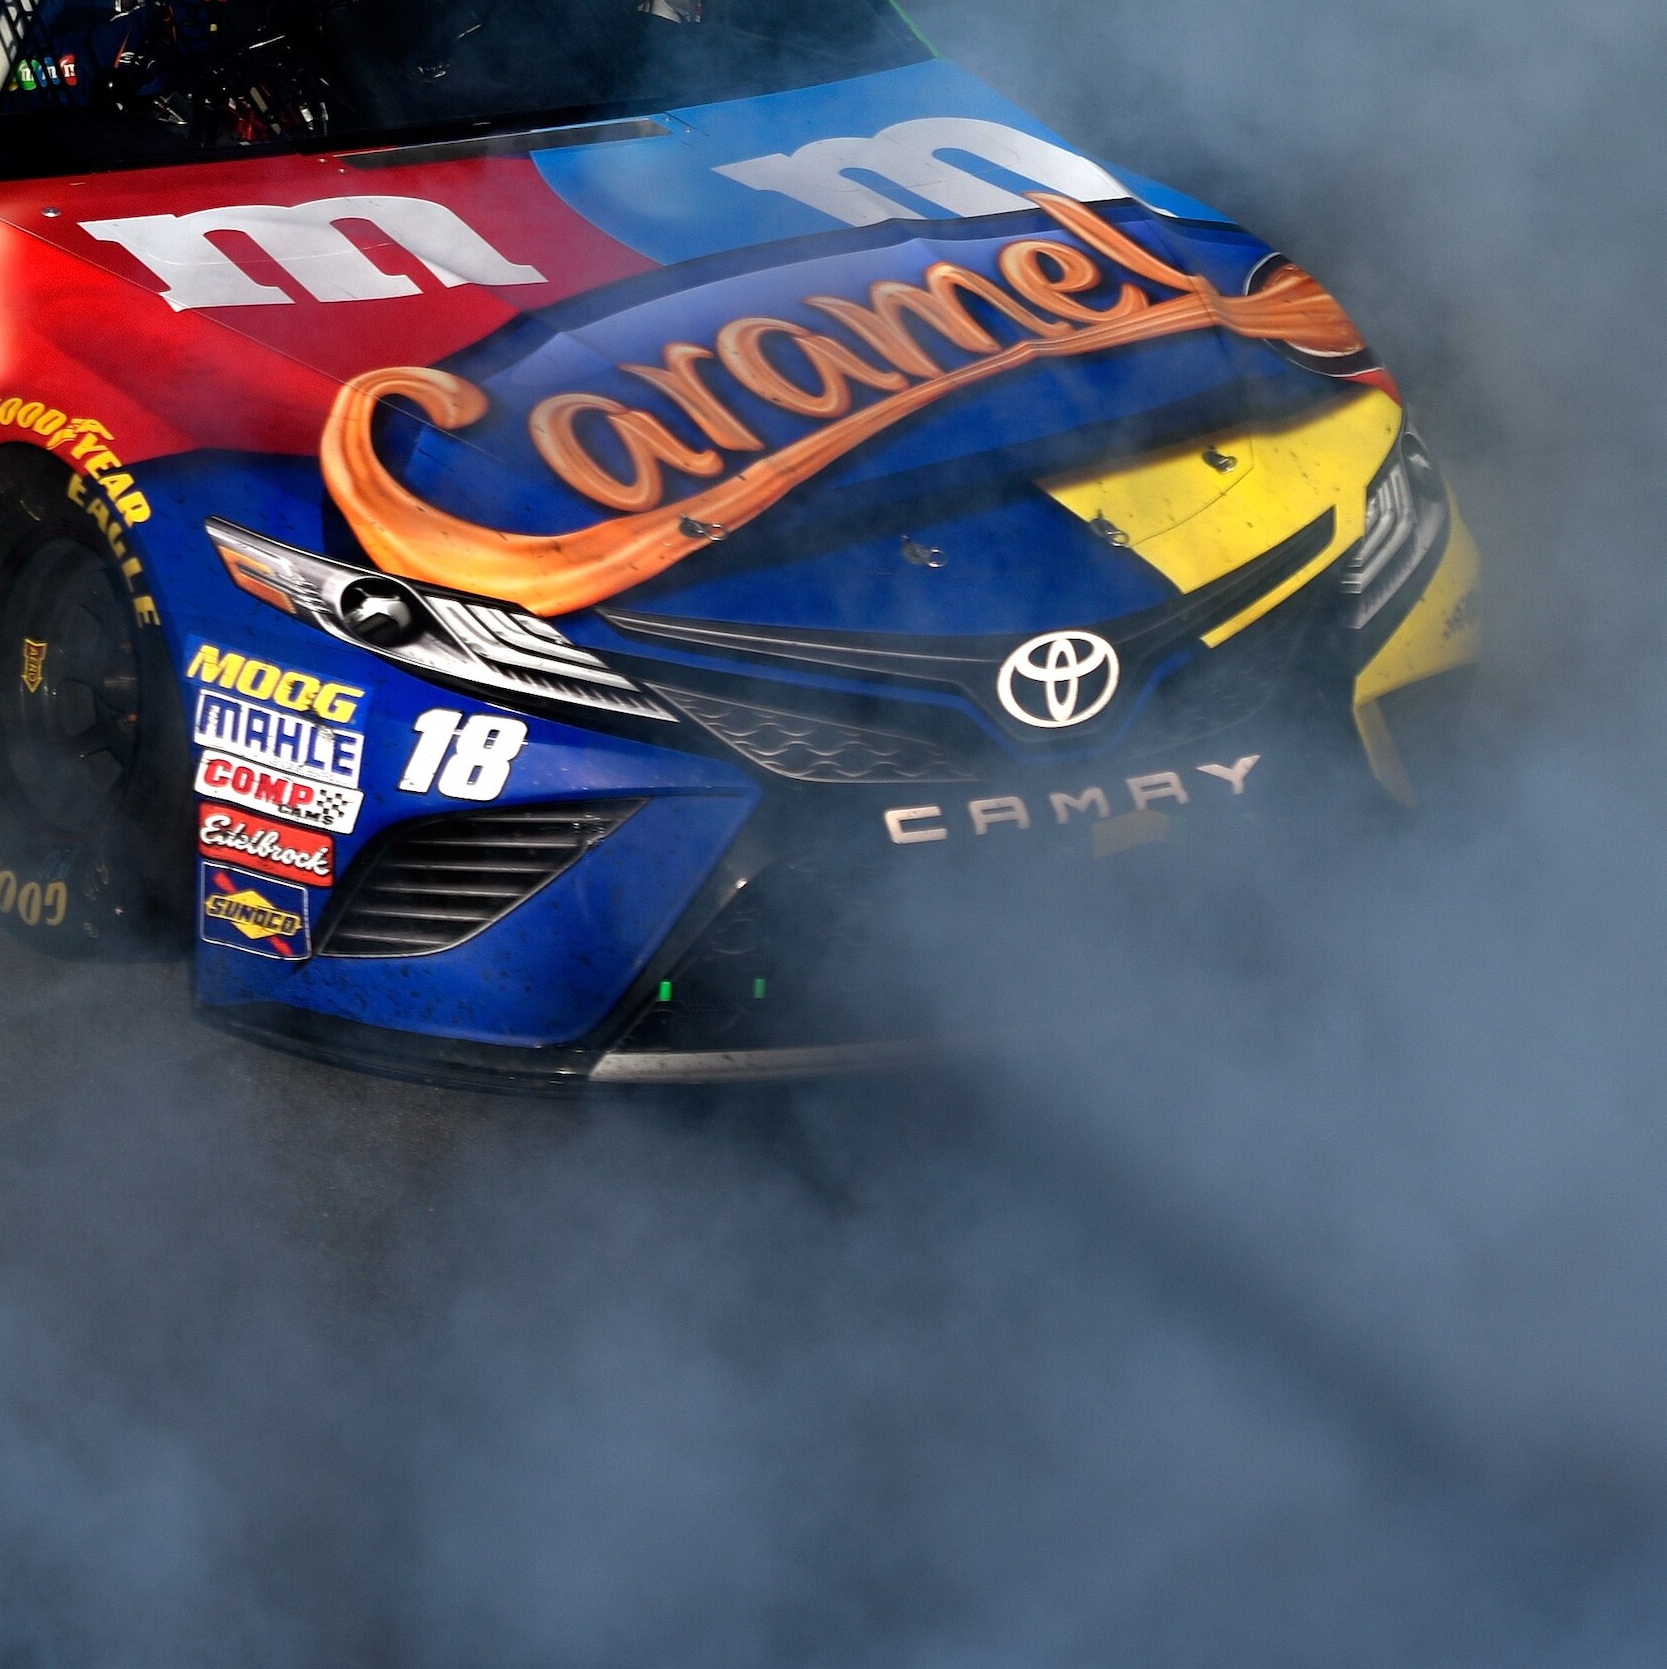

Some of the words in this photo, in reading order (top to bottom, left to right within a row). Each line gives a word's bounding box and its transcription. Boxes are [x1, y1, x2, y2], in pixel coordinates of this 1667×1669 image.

[319, 192, 1227, 616] Caramel
[67, 472, 161, 629] EAGLE
[186, 644, 365, 724] MOOG
[199, 693, 357, 777] MAHLE
[398, 708, 527, 802] 18
[204, 758, 315, 809] COMP
[277, 803, 335, 826] CAMS
[883, 753, 1262, 845] CAMRY
[200, 814, 330, 876] Edelbrock
[208, 896, 298, 933] SUNOCO
